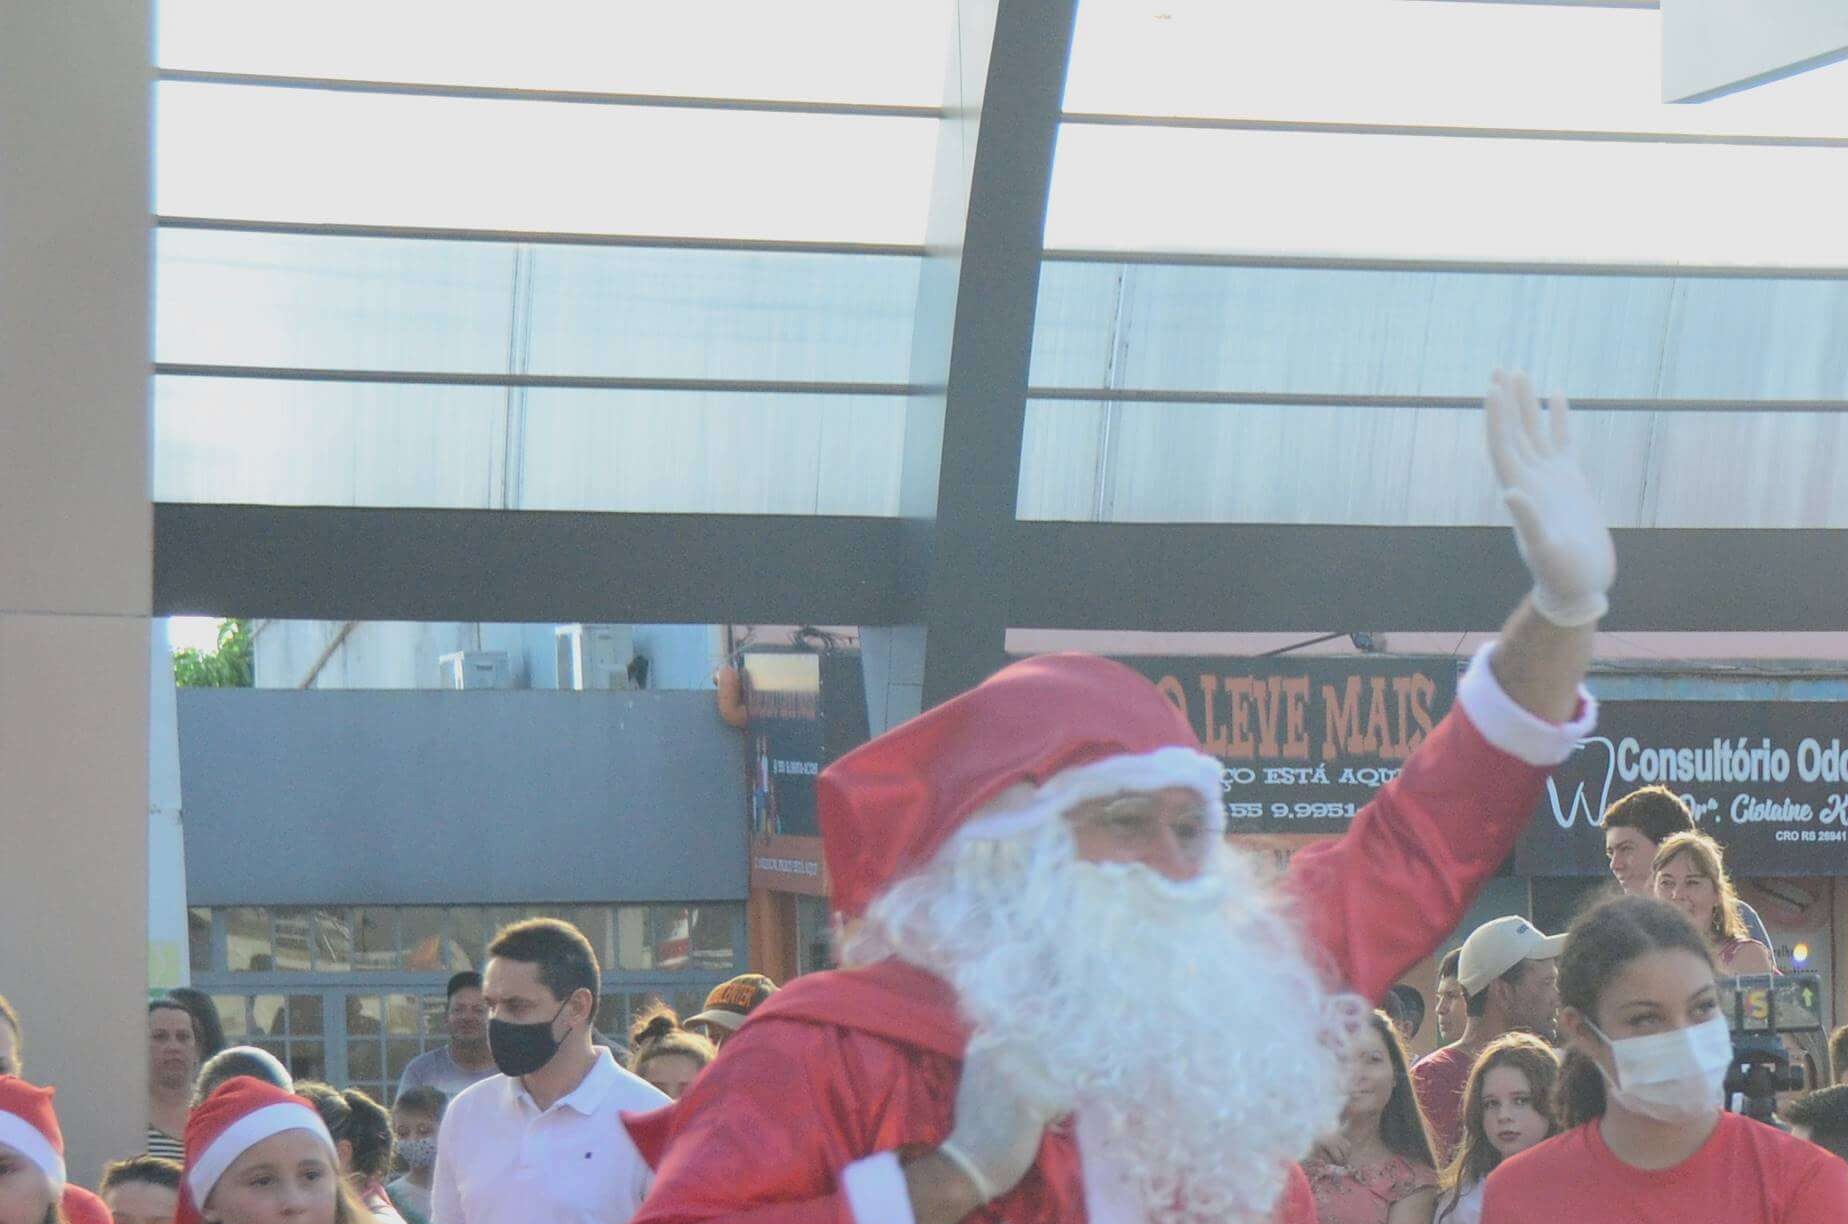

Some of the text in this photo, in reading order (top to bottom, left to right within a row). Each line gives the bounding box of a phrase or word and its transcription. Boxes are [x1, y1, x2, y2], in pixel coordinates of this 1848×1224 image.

[1200, 674, 1310, 759] LEVE
[1322, 672, 1437, 761] MAIS
[1617, 737, 1790, 783] Consultório
[1264, 763, 1332, 785] ESTÁ
[1230, 803, 1263, 817] 55
[1775, 831, 1799, 842] CRO
[1801, 831, 1816, 842] RS
